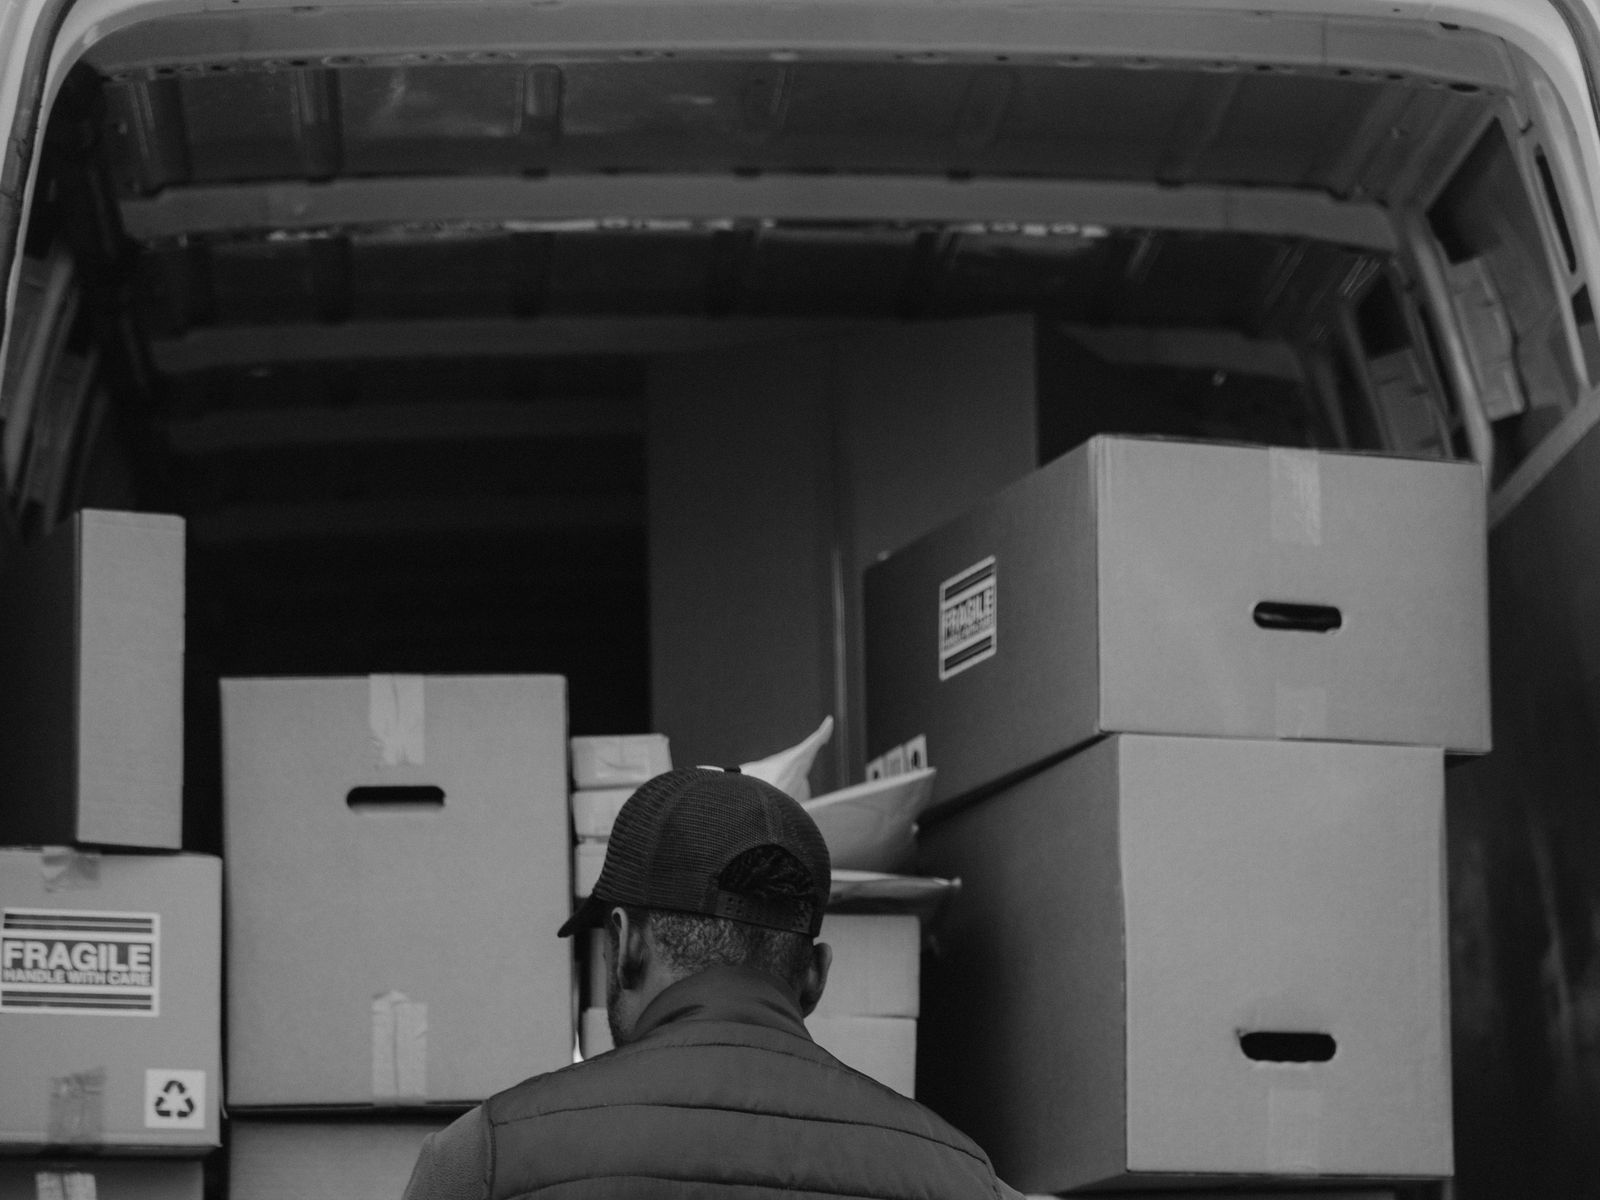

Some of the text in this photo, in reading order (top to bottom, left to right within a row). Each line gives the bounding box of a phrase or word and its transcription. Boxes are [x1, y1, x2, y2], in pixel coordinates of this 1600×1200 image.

[3, 940, 151, 972] FRAGILE
[2, 968, 150, 986] HANDLE WITH CARE
